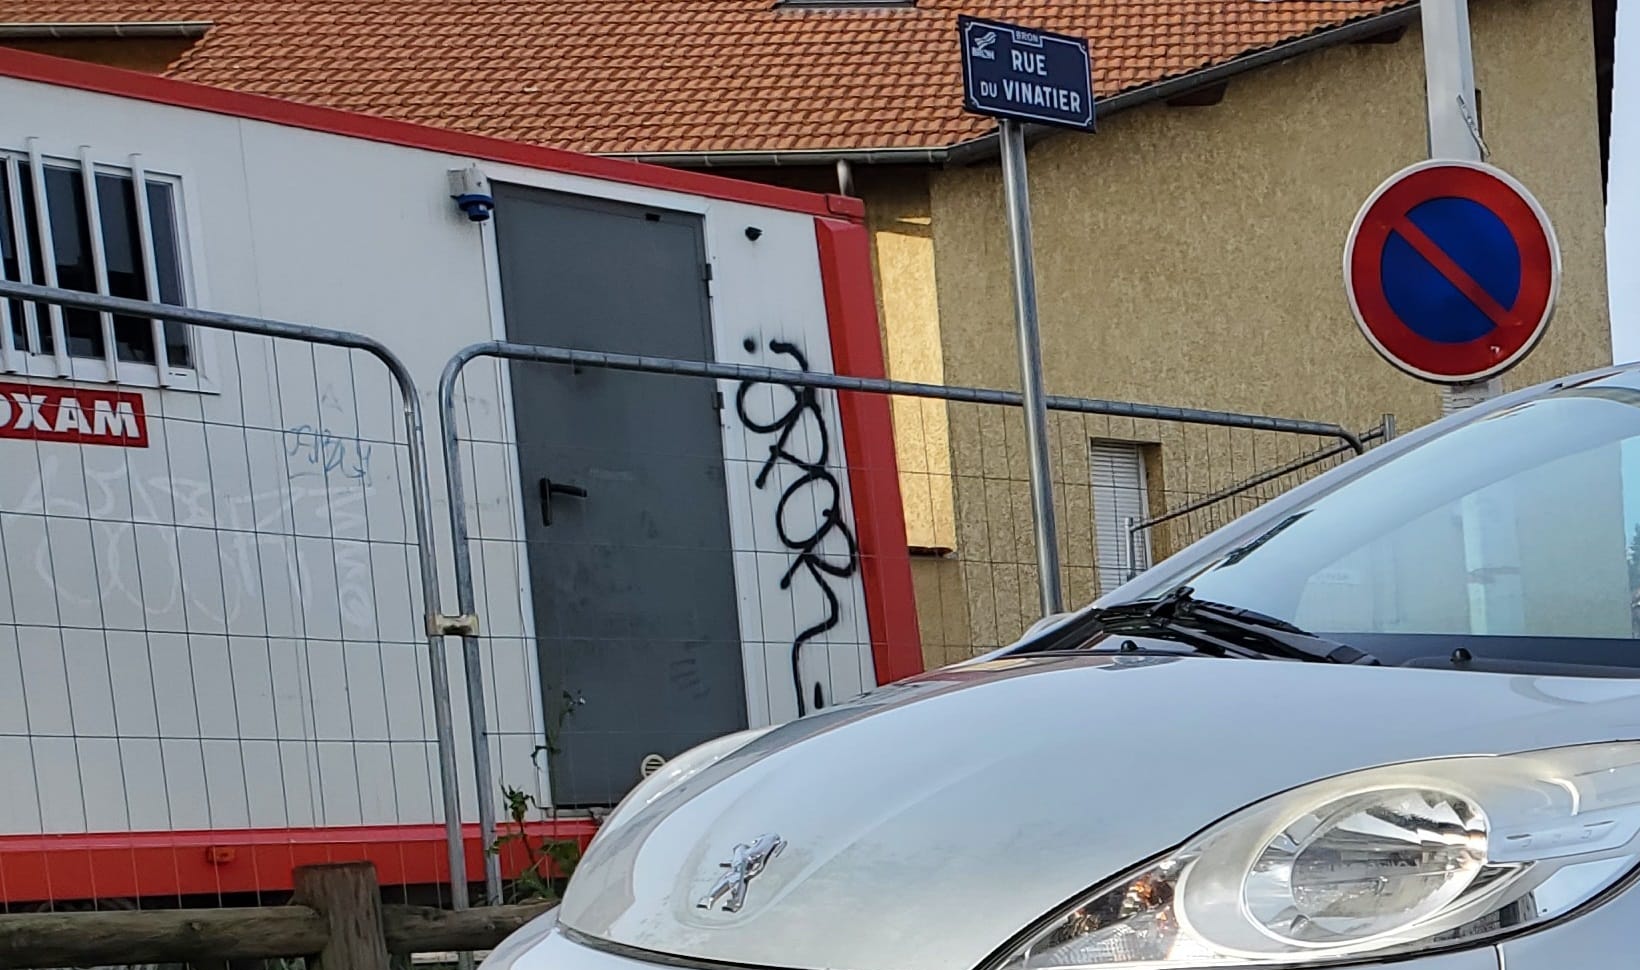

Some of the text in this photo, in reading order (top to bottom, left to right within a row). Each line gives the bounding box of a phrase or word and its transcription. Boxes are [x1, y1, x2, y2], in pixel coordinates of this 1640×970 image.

[1015, 30, 1039, 43] BRON
[1011, 49, 1048, 76] RUE
[980, 78, 1082, 114] DU VINATIER
